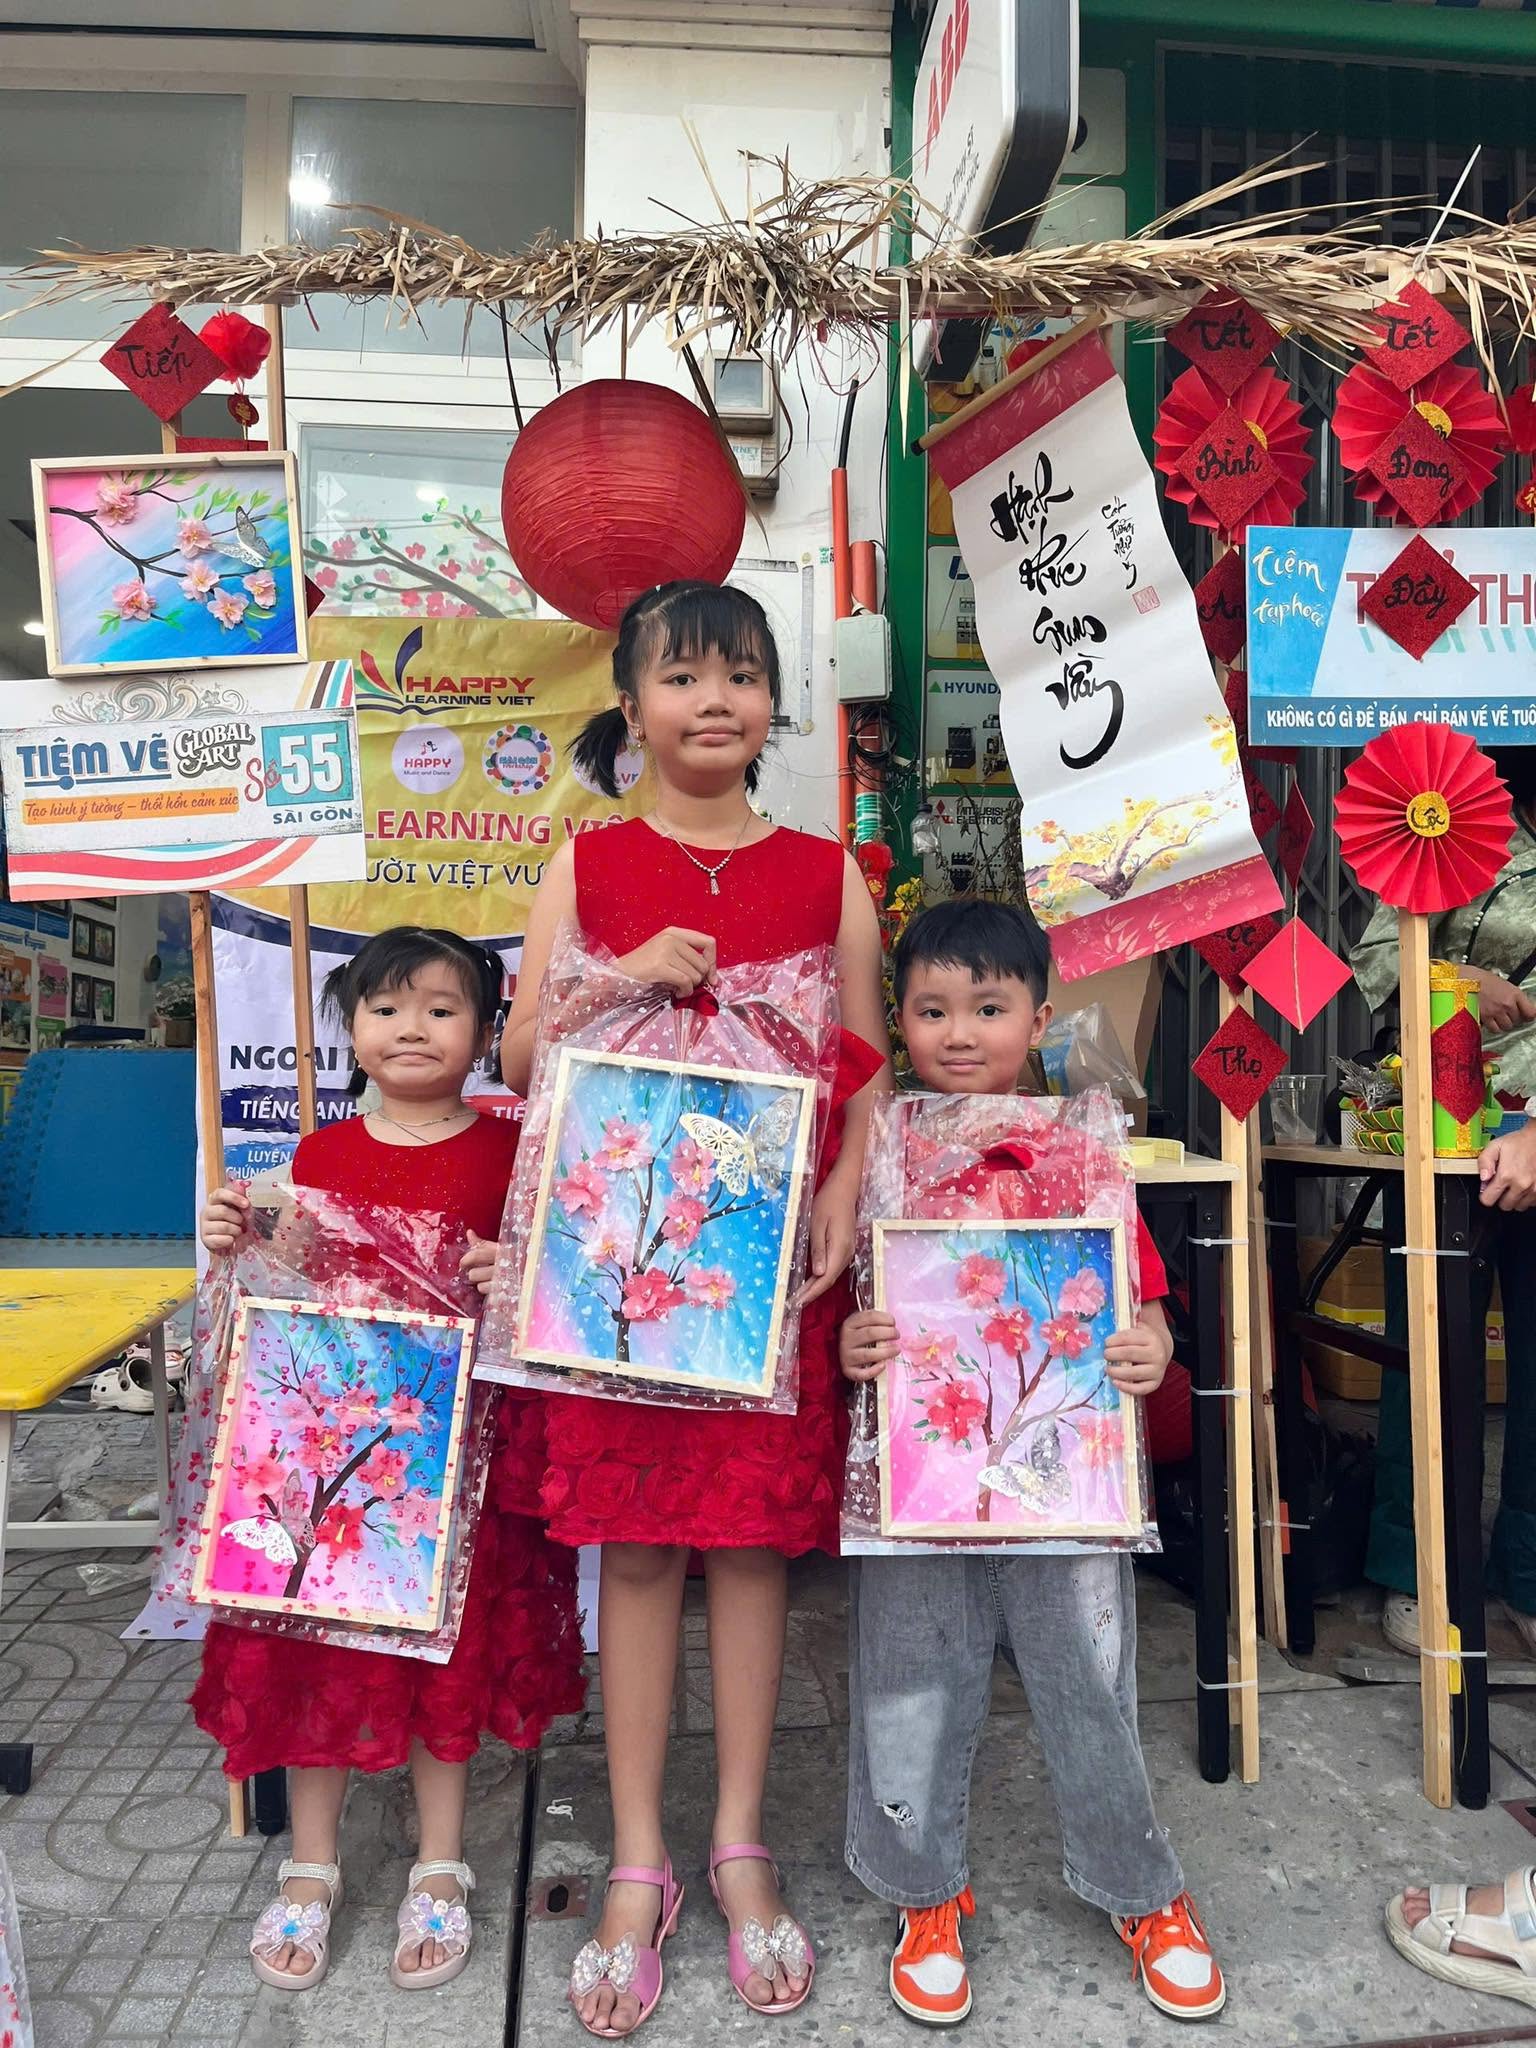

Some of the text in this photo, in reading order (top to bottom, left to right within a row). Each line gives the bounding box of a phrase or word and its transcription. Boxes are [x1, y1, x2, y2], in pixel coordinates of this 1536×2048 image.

[925, 0, 970, 178] ABB
[1187, 308, 1255, 350] Tết
[1384, 316, 1439, 351] Tết
[115, 336, 192, 384] Tiếp
[1196, 438, 1263, 482] Bình
[1387, 450, 1455, 497] Đong
[1468, 573, 1536, 625] TH
[405, 676, 535, 694] HAPPY
[405, 694, 536, 707] LEARNING VIET
[944, 682, 1001, 695] HYUND
[1267, 704, 1314, 728] KHÔNG
[1317, 704, 1336, 728] CÓ
[1339, 704, 1353, 728] GÌ
[1356, 701, 1378, 728] ĐỂ
[1440, 703, 1468, 727] BÁN
[1471, 704, 1488, 727] VÉ
[16, 722, 344, 802] TIỆM VẼ GLOBAL Số 55
[177, 743, 241, 778] ART
[404, 757, 452, 769] HAPPY
[26, 803, 48, 821] Tạo
[50, 803, 77, 816] hình
[78, 802, 88, 821] ý
[91, 798, 125, 820] tưởng
[191, 793, 217, 809] cảm
[219, 792, 239, 806] xúc
[273, 805, 353, 825] SÀI GÒN
[366, 857, 545, 890] ƯỜI VIỆT VƯ
[1211, 1045, 1263, 1079] Thọ
[492, 1100, 527, 1123] TIẾ
[225, 1164, 267, 1180] CHỨN
[247, 1149, 292, 1166] LUYỆN
